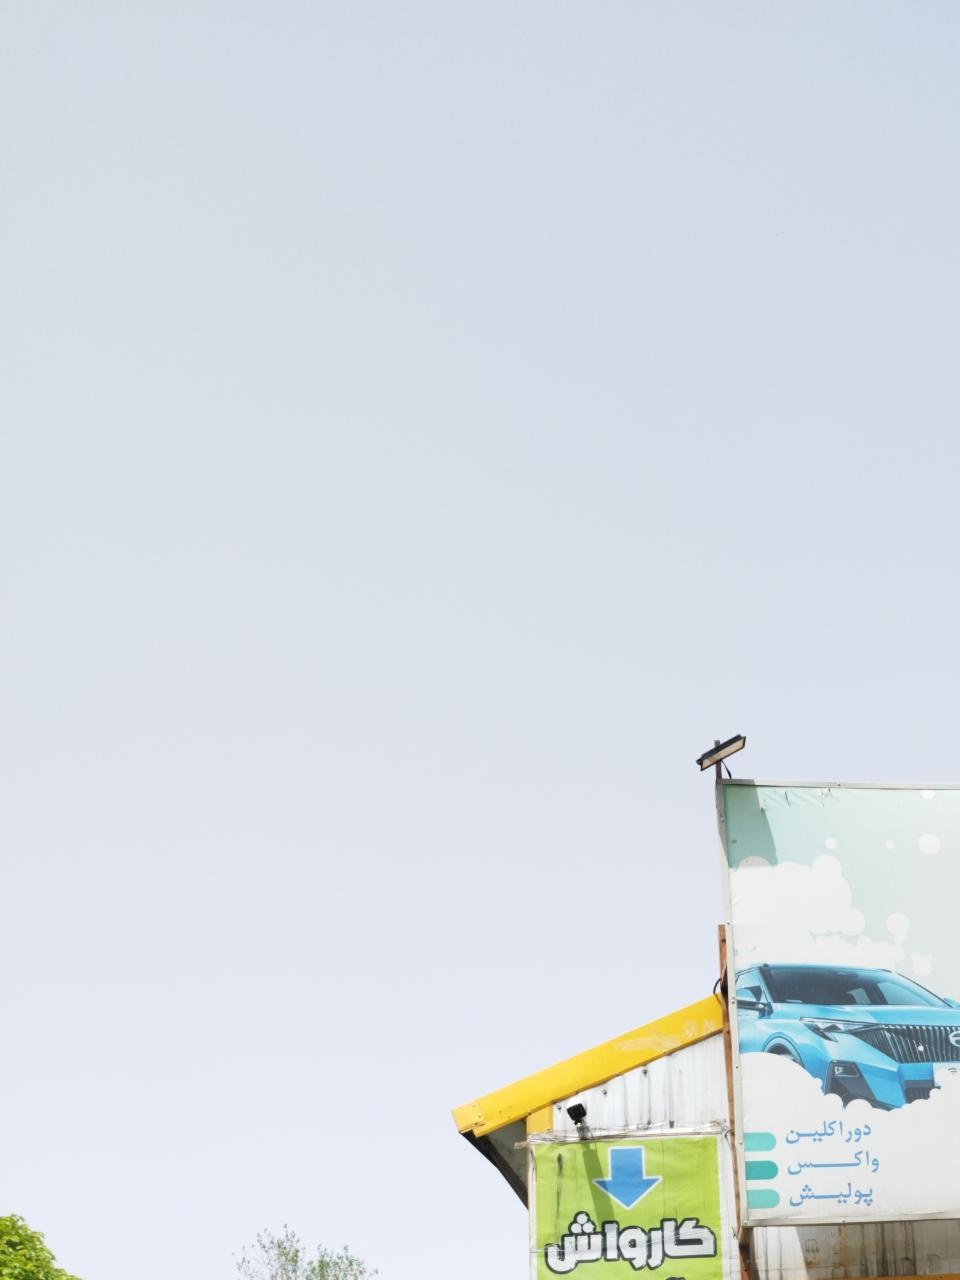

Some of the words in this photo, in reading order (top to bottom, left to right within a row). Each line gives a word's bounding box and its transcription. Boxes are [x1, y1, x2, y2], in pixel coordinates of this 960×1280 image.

[787, 1150, 880, 1175] واکس
[789, 1182, 873, 1207] پولیش
[544, 1210, 718, 1274] کارواش
